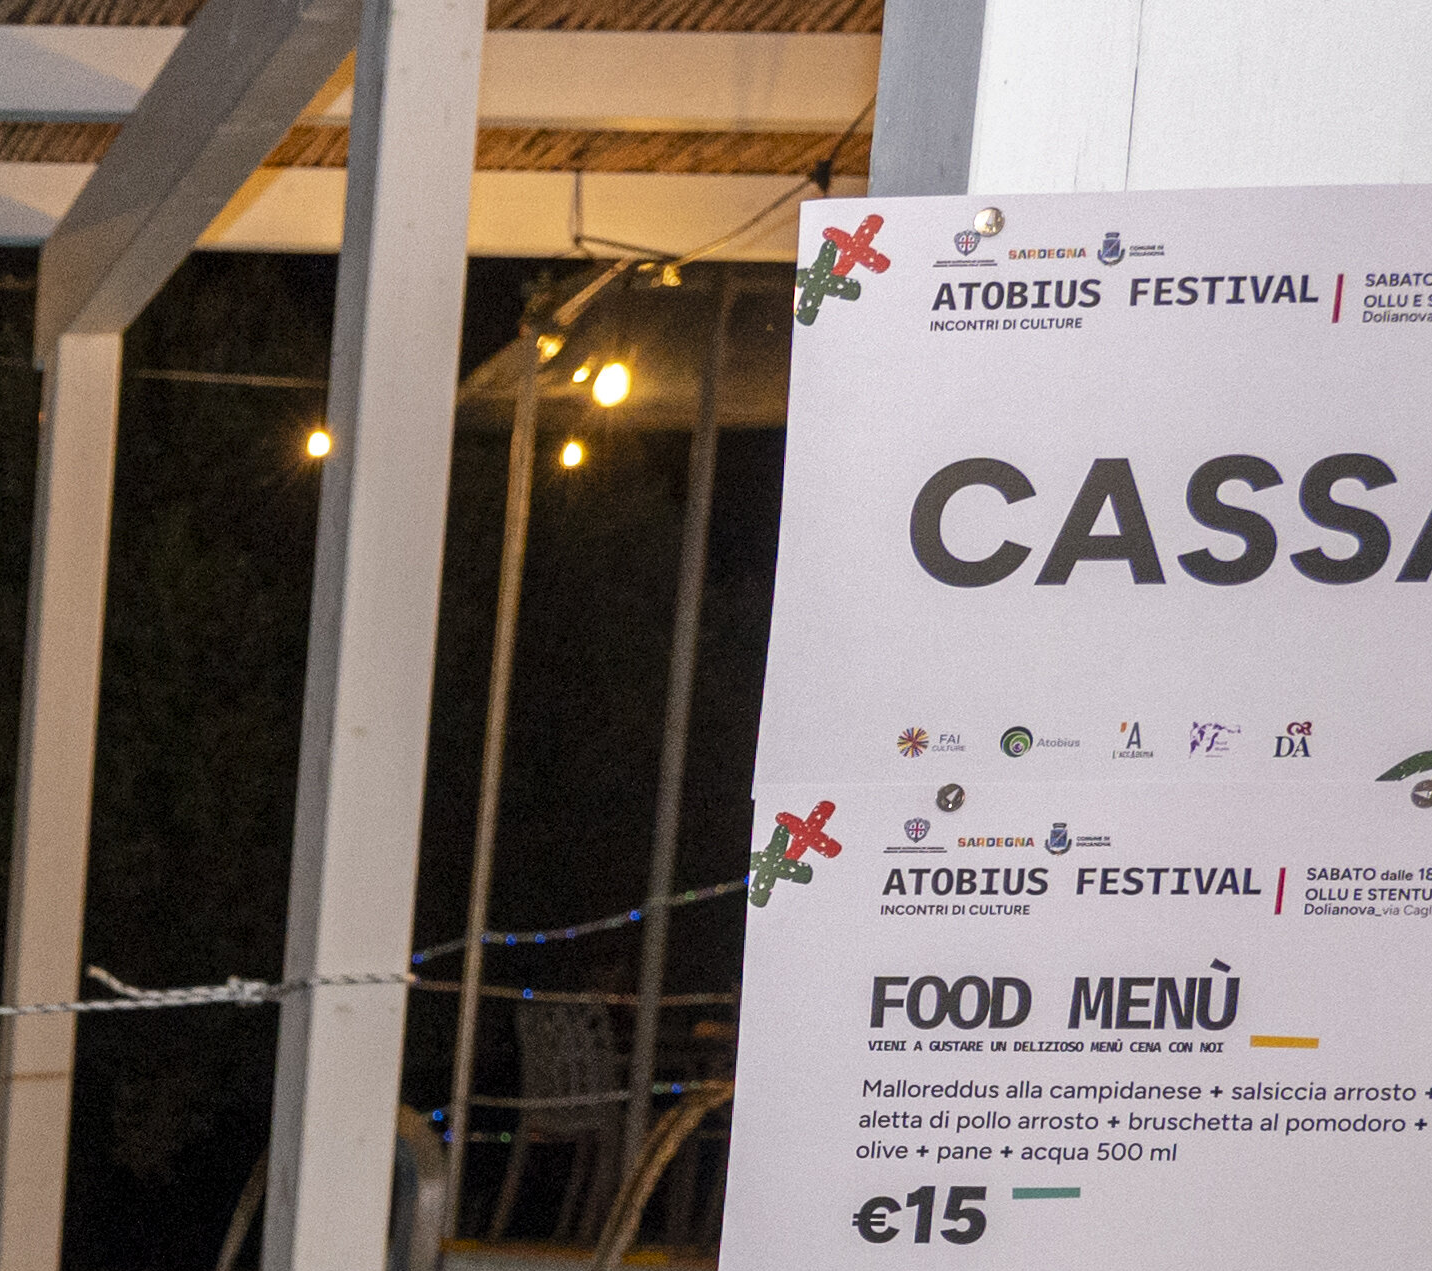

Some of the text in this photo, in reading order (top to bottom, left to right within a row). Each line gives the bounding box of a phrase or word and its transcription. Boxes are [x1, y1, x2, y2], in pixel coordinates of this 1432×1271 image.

[1008, 247, 1086, 260] SARDEGNA
[931, 275, 1319, 311] ATOBIUS FESTIVAL
[1363, 294, 1421, 308] OLLU E
[929, 317, 1082, 332] INCONTRI DI CULTURE
[909, 453, 1432, 589] CASS
[939, 734, 960, 744] FAI
[1036, 737, 1080, 748] Atobius
[957, 836, 1034, 848] SARDEGNA
[882, 867, 1262, 896] ATOBIUS FESTIVAL
[1306, 867, 1413, 881] SABATO dalle
[1305, 888, 1432, 900] OLLU E STENTU
[880, 904, 1030, 916] INCONTRI DI CULTURE
[870, 958, 1240, 1030] FOOD MENÙ
[868, 1038, 1223, 1053] VIENI A GUSTARE UN DELIZIOSO MENÙ CENA CON NOI
[862, 1079, 1416, 1104] Malloreddus alla campidanese salsiccia arrosto
[858, 1110, 1406, 1136] aletta di pollo arrosto bruschetta al pomodoro
[855, 1140, 1177, 1165] olive pane acqua 500 ml
[852, 1185, 987, 1245] €15
